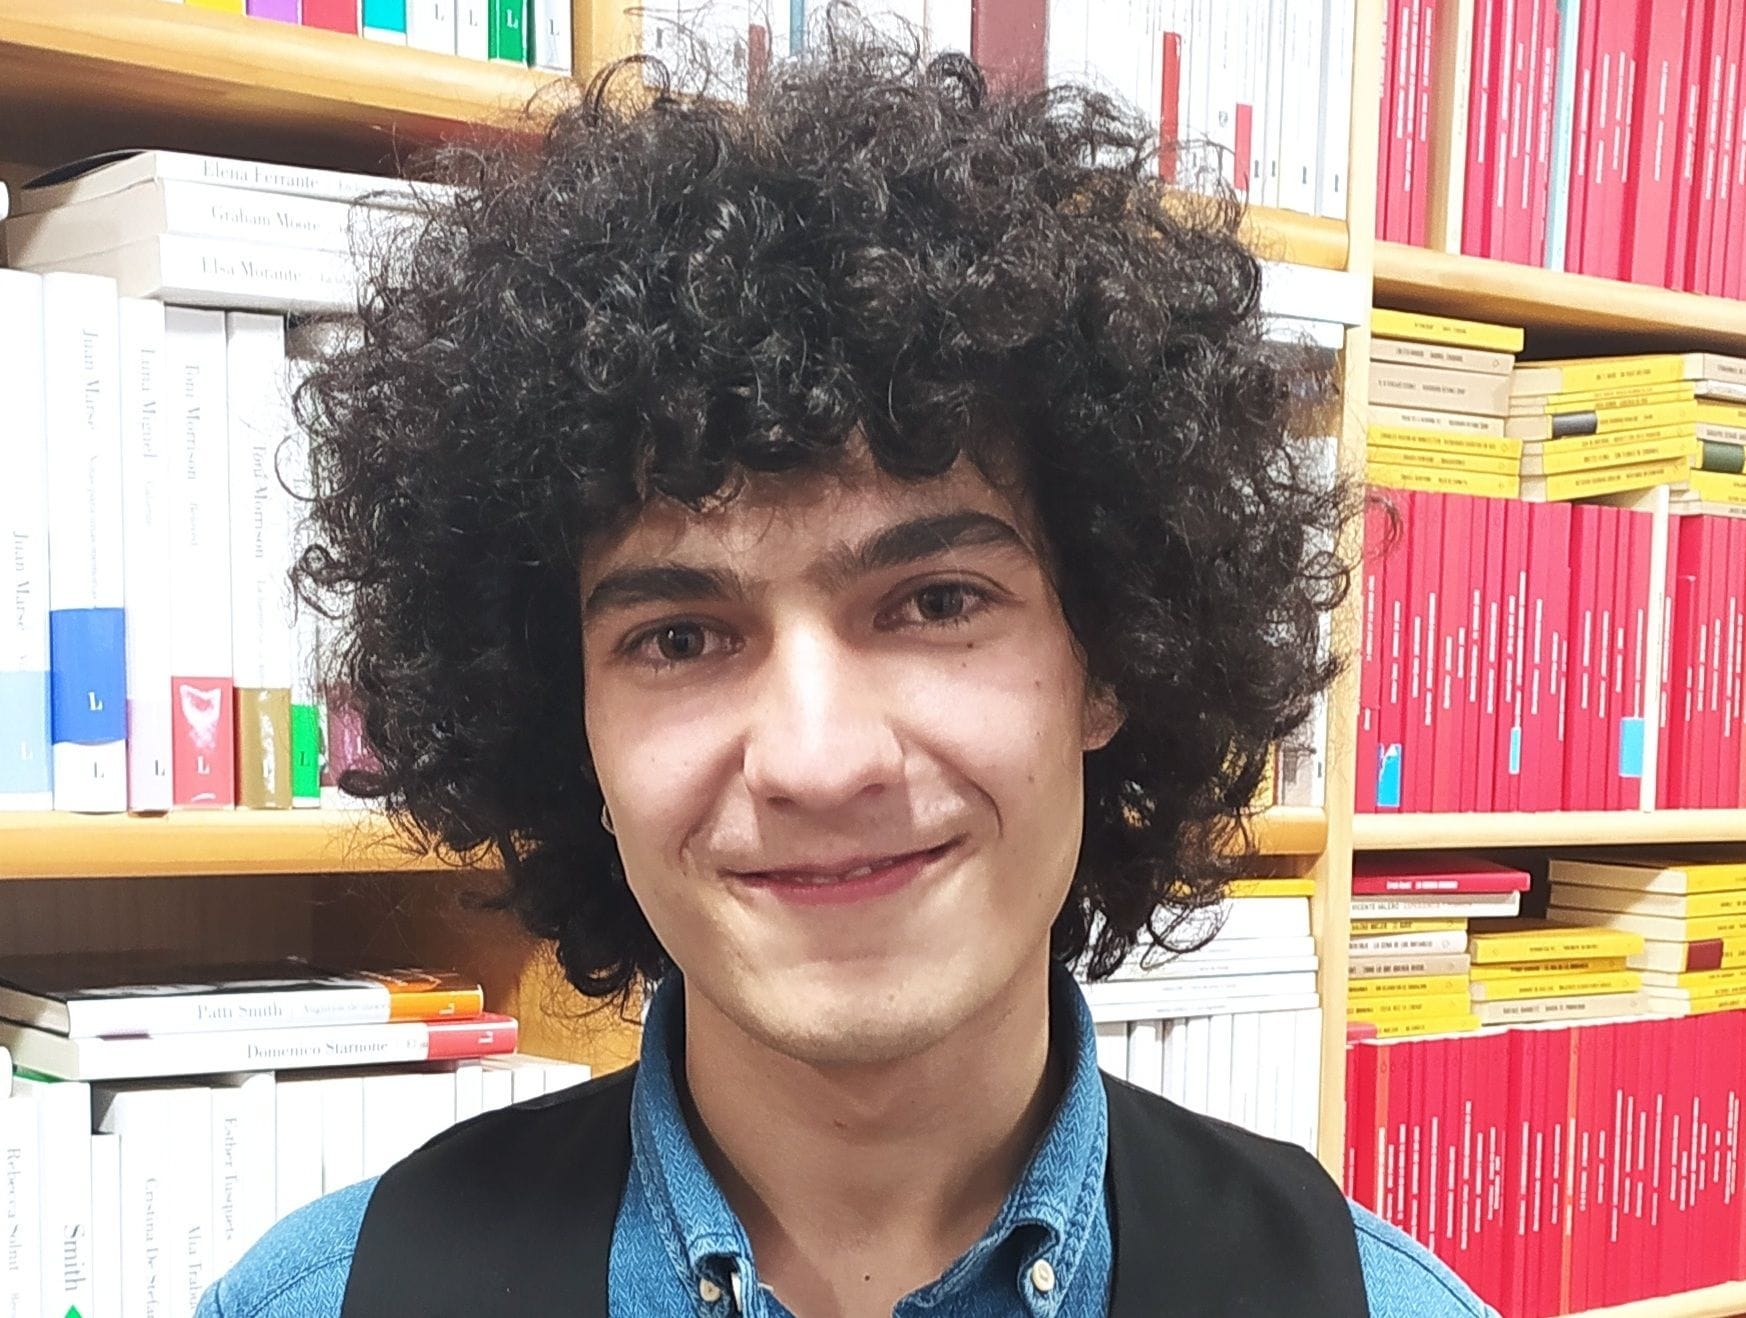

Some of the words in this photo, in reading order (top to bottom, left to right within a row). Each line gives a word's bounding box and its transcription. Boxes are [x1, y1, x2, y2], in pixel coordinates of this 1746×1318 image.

[507, 9, 518, 28] L
[202, 159, 248, 181] Elena
[254, 166, 318, 189] Ferrante
[211, 205, 270, 227] Graham
[276, 212, 320, 232] Moore
[202, 256, 235, 275] Elsa
[241, 260, 303, 282] Morante
[81, 328, 99, 371] Juan
[140, 347, 156, 391] Luna
[185, 363, 201, 398] Toni
[139, 399, 157, 458] Miguel
[186, 406, 202, 480] Morrison
[252, 445, 268, 479] Toni
[254, 484, 268, 559] Morrison
[12, 530, 30, 572] Juan
[89, 692, 103, 711] L
[155, 760, 165, 776] L
[197, 756, 210, 775] L
[300, 751, 311, 766] L
[198, 1004, 233, 1020] Patti
[239, 1003, 283, 1017] Smith
[439, 1002, 454, 1014] L
[247, 1044, 321, 1059] Domenico
[325, 1041, 388, 1054] Starnone
[478, 1031, 493, 1043] L
[224, 1118, 238, 1167] Esther
[7, 1148, 21, 1218] Rebecca
[145, 1178, 158, 1241] Cristina
[221, 1173, 239, 1241] Tusquets
[9, 1224, 23, 1271] Solnit
[188, 1225, 201, 1255] Alia
[63, 1224, 86, 1292] Smith
[146, 1248, 158, 1269] De
